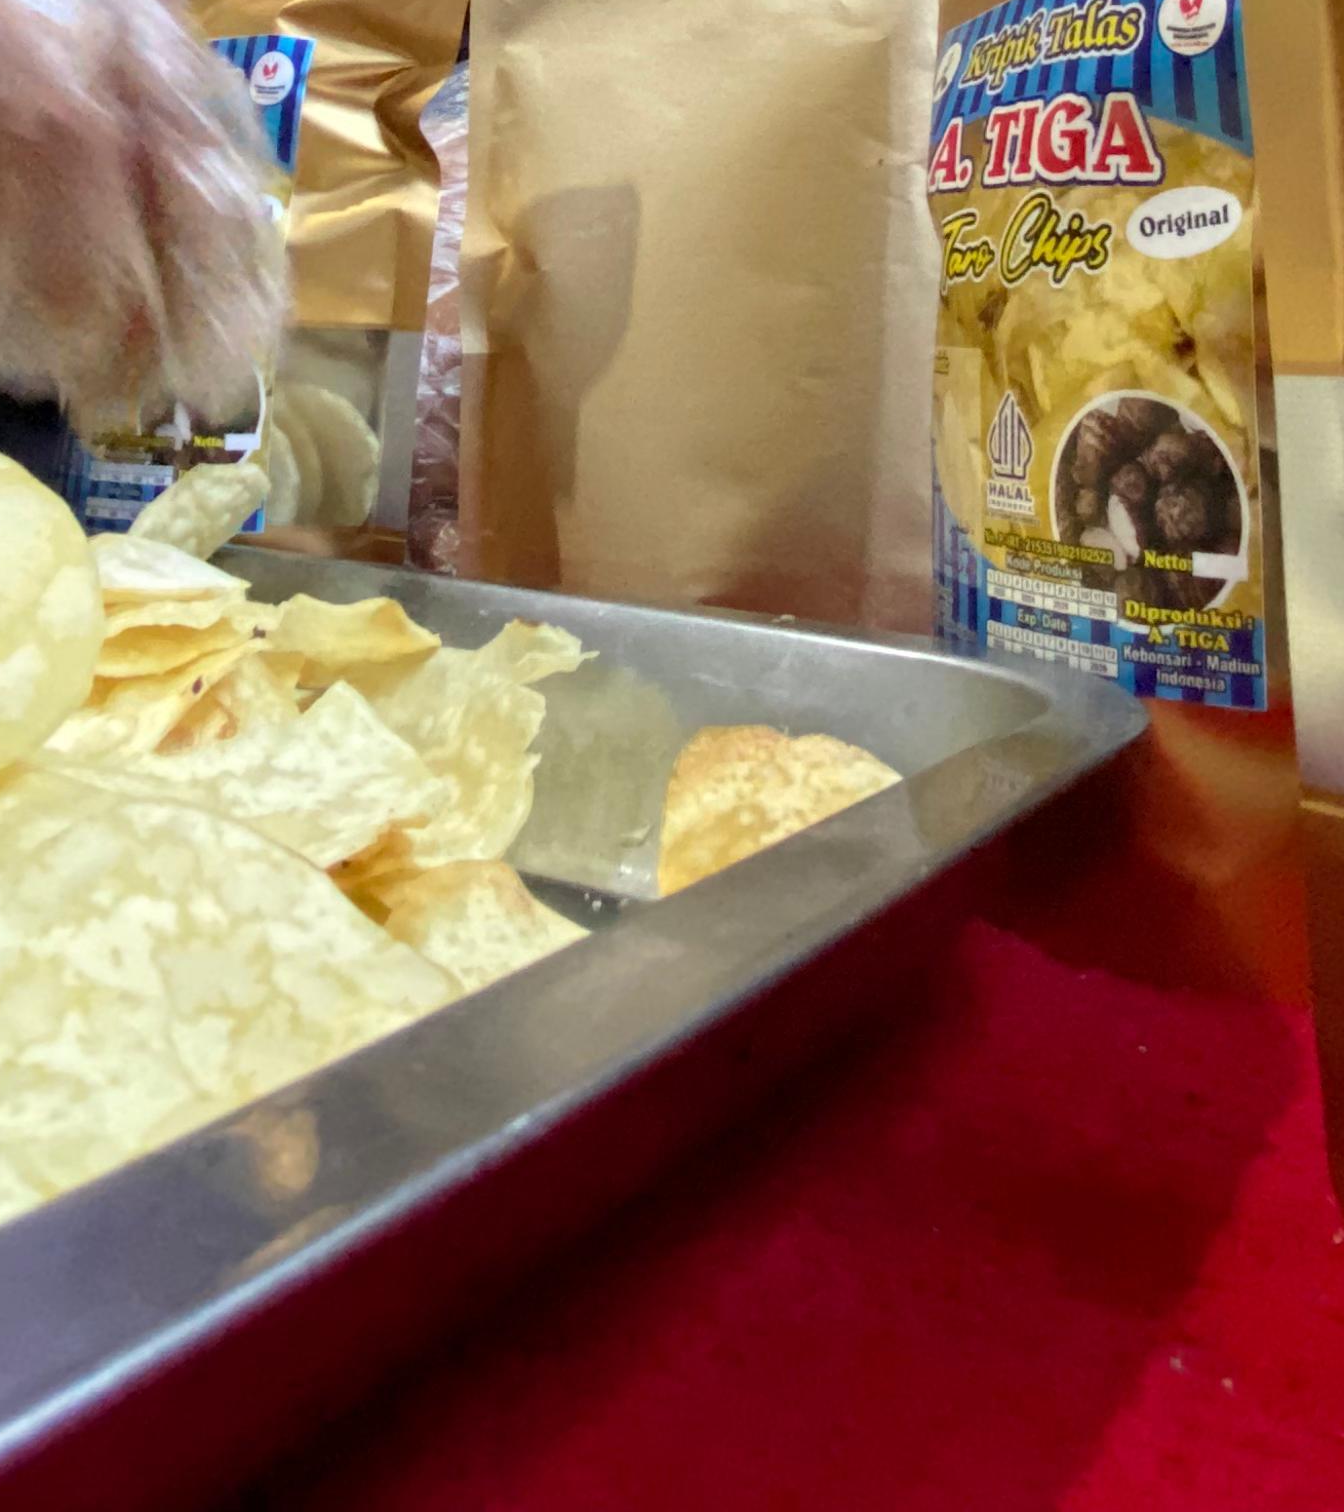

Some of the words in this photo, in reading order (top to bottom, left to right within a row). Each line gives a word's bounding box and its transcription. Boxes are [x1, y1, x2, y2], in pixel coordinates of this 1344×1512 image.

[964, 14, 1043, 88] Kripik
[930, 122, 968, 185] A.
[988, 100, 1155, 177] TIGA
[1140, 205, 1229, 237] Original
[943, 212, 994, 288] Taro
[1001, 193, 1111, 284] Chips
[989, 483, 1032, 502] HALAL
[1125, 600, 1241, 628] Diproduksi
[1148, 626, 1169, 644] A.
[1175, 630, 1229, 651] TIGA
[1124, 646, 1192, 666] Kebonsari
[1207, 656, 1260, 674] Madiun
[1156, 670, 1225, 692] Indonesia
